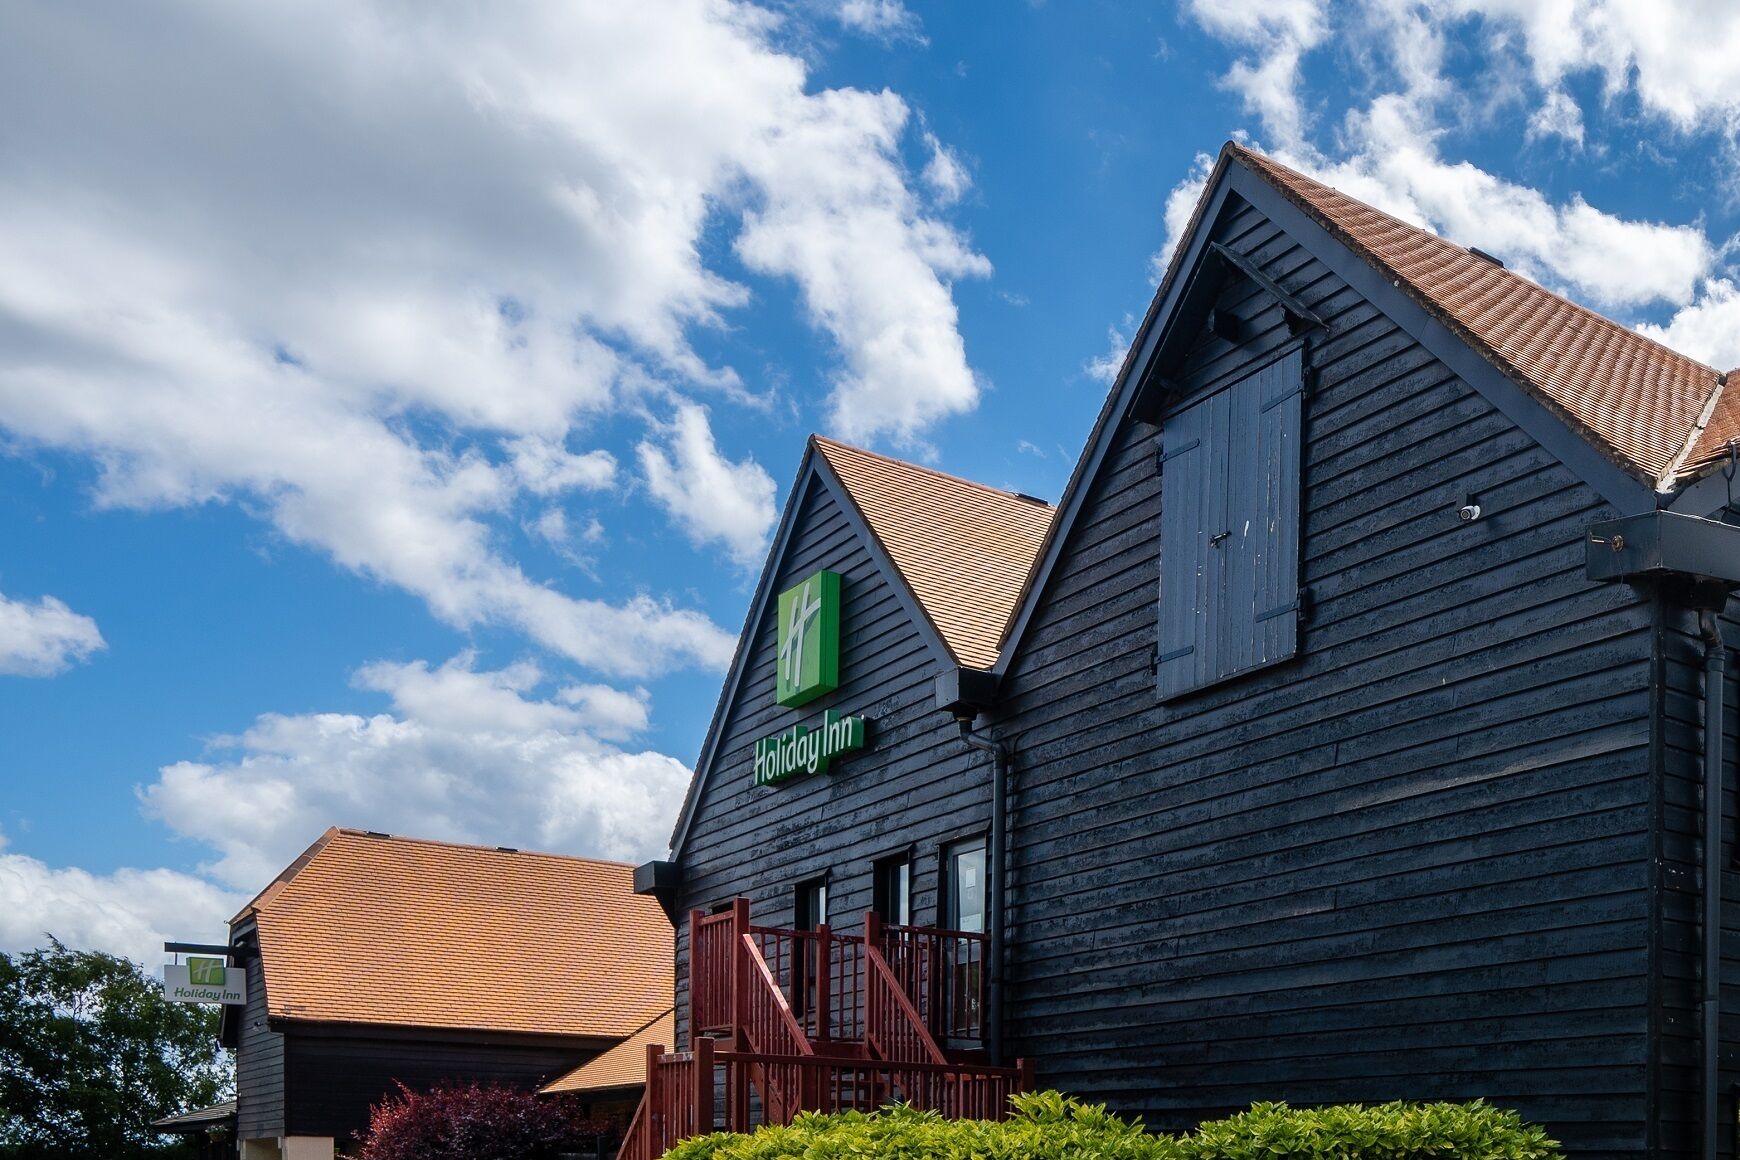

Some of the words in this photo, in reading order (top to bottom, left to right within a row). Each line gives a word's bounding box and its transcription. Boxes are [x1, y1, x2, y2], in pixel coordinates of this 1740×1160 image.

[754, 725, 820, 785] Holiday
[823, 709, 854, 757] Inn
[174, 987, 221, 1001] Holiday
[222, 989, 240, 1000] Inn
